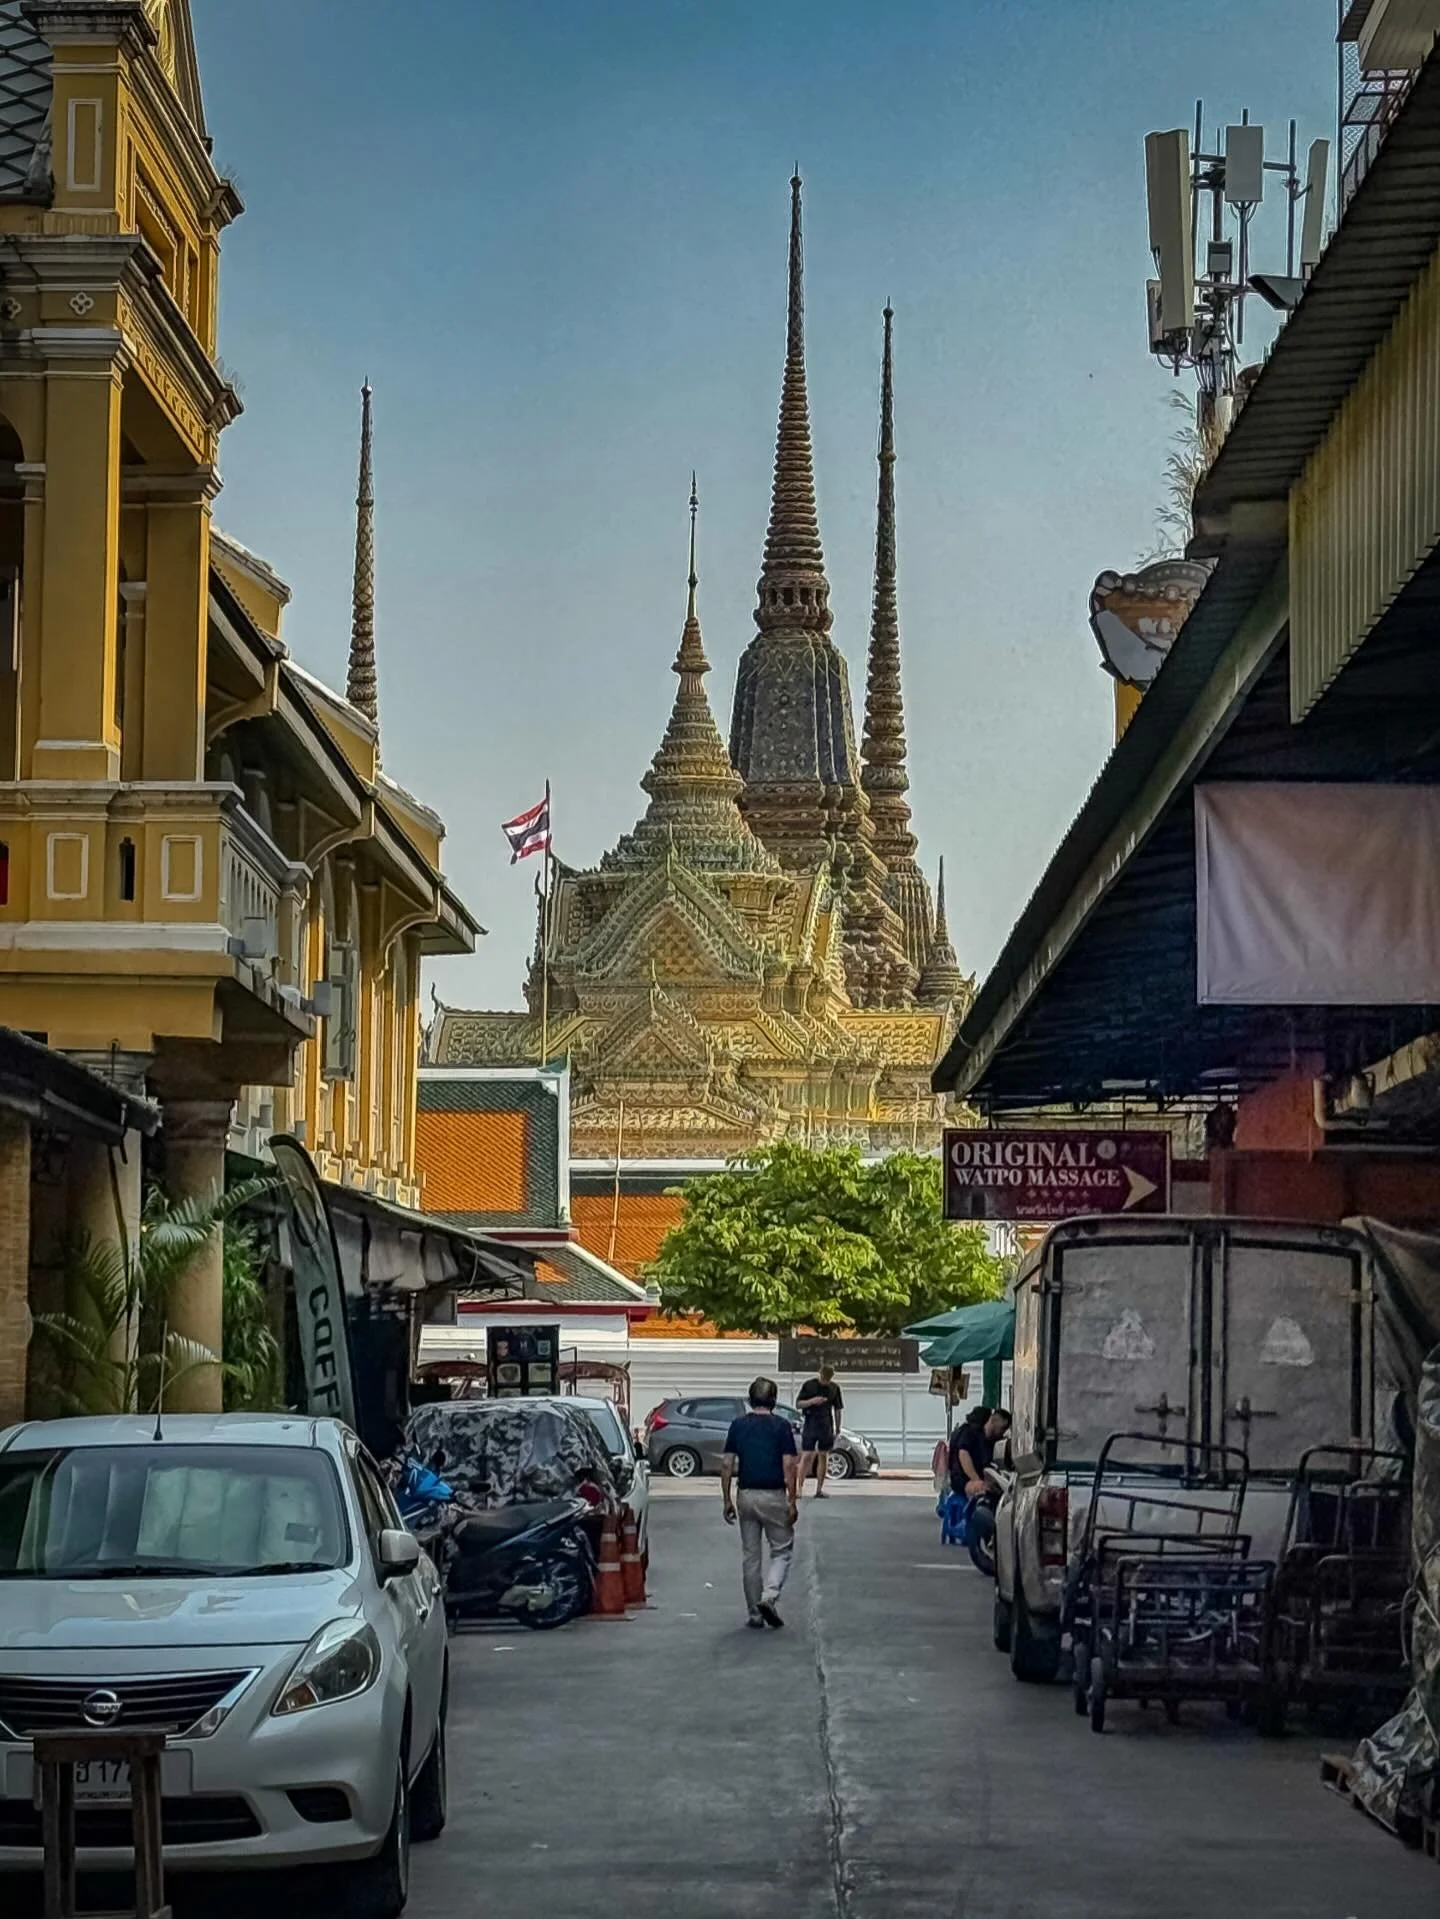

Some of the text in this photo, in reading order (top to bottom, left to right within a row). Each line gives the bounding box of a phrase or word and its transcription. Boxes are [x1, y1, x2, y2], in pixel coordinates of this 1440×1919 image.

[951, 1141, 1096, 1167] ORIGINAL
[953, 1167, 1121, 1187] WATPO MASSAGE
[309, 1284, 341, 1418] COFF
